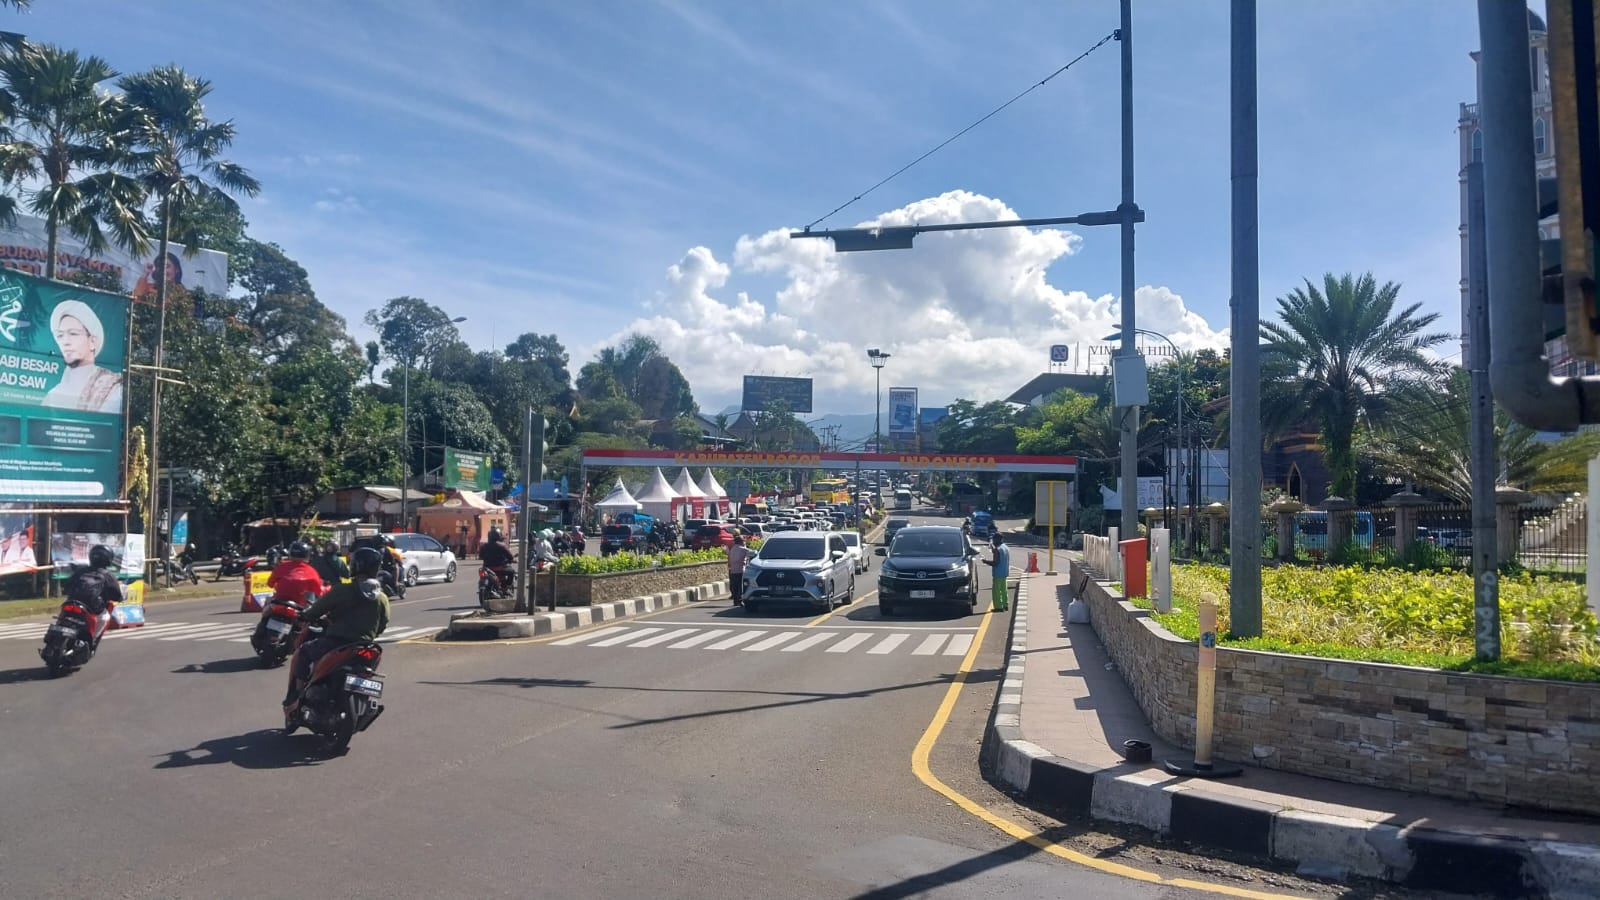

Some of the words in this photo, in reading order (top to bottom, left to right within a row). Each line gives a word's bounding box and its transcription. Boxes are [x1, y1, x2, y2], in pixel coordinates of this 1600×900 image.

[21, 357, 60, 375] BESAR
[19, 374, 47, 390] SAW
[674, 452, 763, 465] KABUPATEN
[766, 453, 820, 466] BOGOR
[900, 455, 996, 468] INDONESIA
